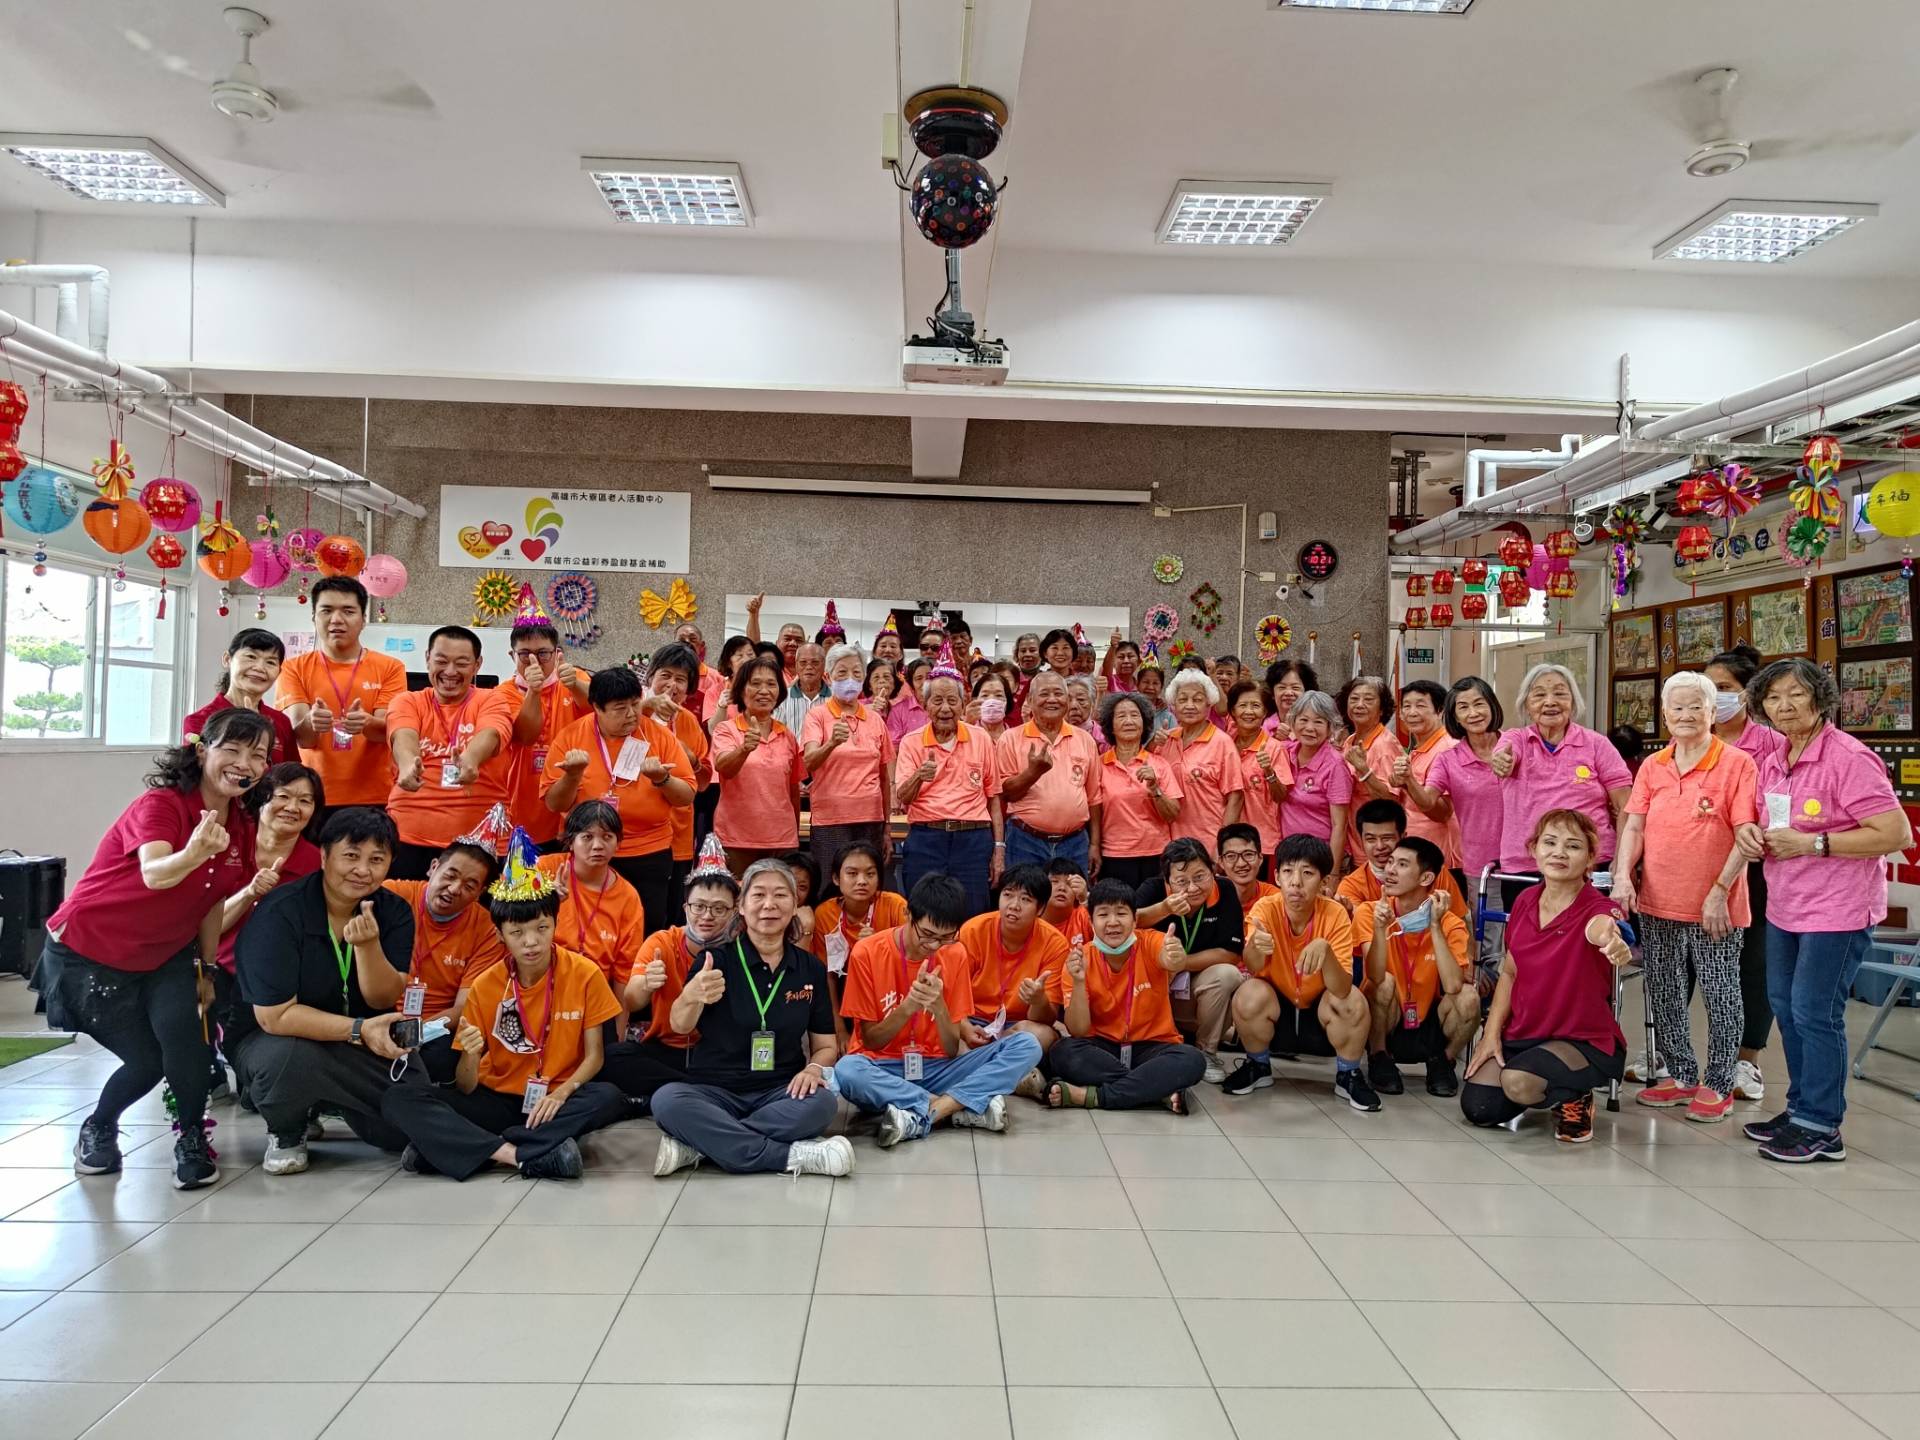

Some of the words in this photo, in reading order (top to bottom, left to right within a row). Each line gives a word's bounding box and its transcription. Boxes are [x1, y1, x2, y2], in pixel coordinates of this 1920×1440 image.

[550, 491, 665, 504] 高雄市大寮區老人活動中心
[543, 556, 667, 568] 高雄市公益彩券盈餘基金補助
[757, 1050, 769, 1059] 77
